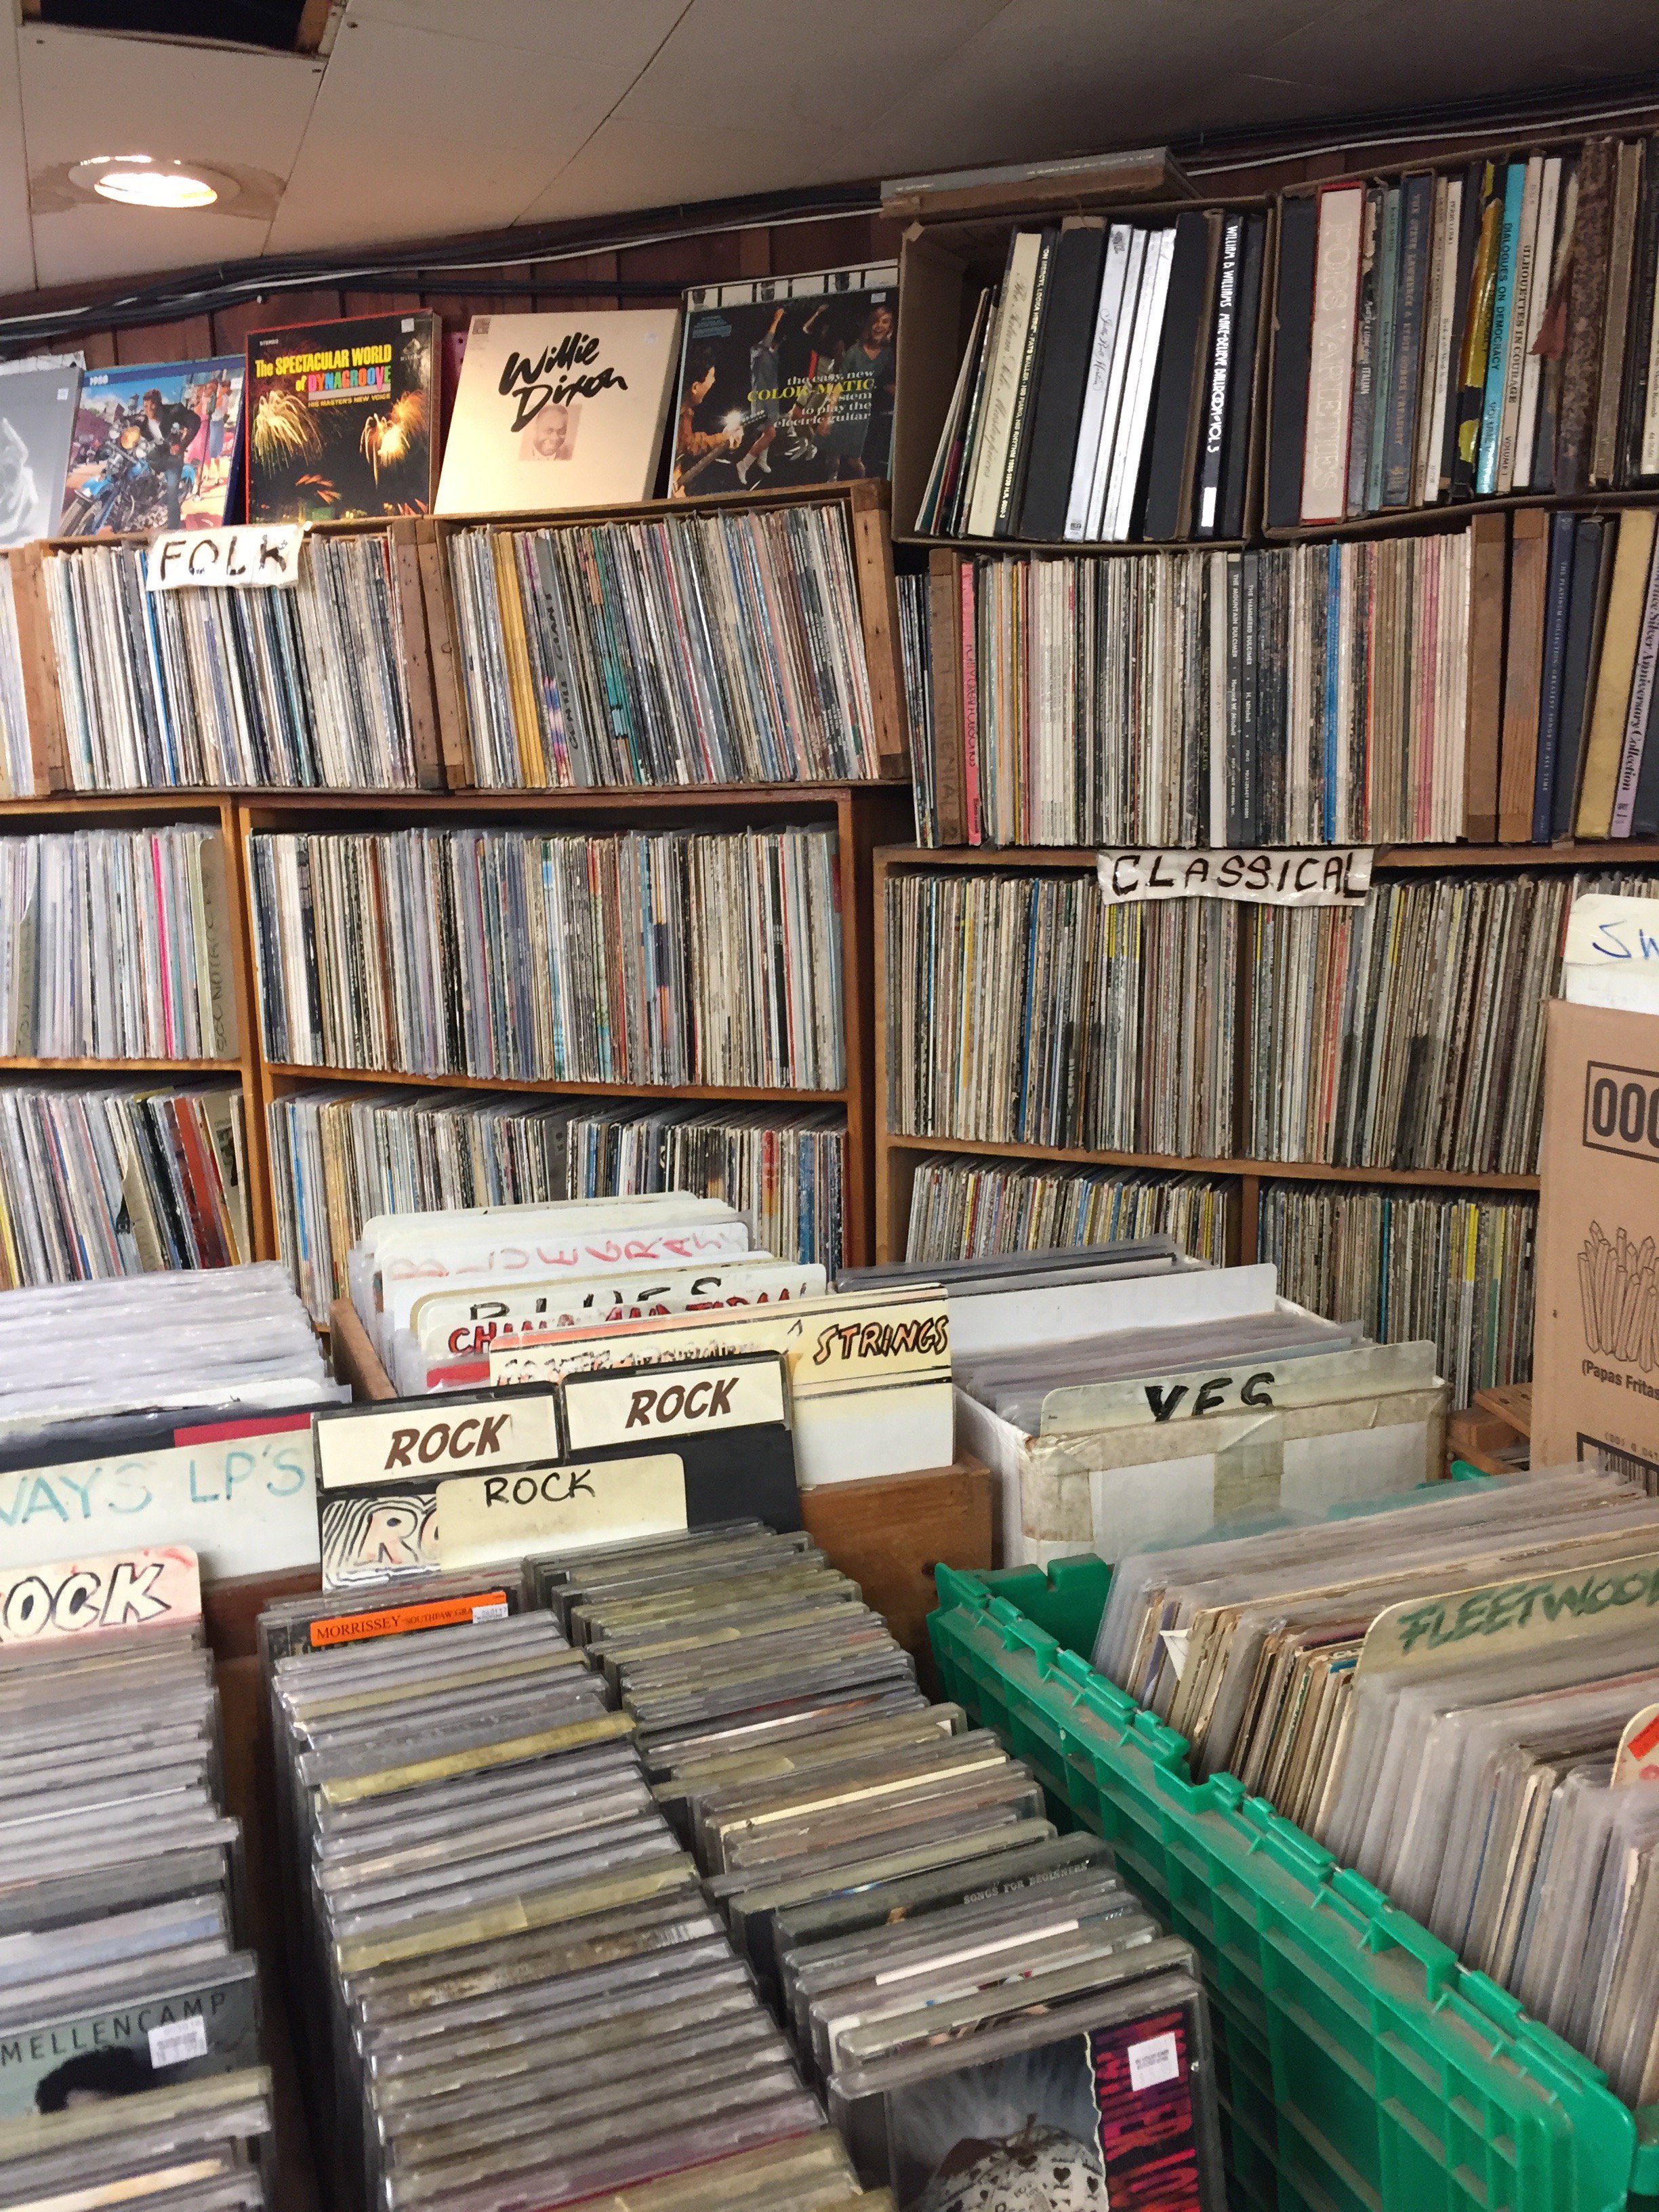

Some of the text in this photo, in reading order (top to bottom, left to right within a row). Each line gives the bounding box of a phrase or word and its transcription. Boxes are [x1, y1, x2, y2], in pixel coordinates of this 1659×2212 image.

[1223, 224, 1237, 260] WILLIAM
[1218, 269, 1233, 308] WILLIAMS
[1490, 222, 1513, 371] DIALOGUES ON DEMOCRACY
[1025, 336, 1035, 354] FATS
[1213, 312, 1230, 366] MAKE-BELIEVE
[1311, 220, 1352, 491] POPS VARIETIES
[1513, 329, 1523, 344] IN
[255, 344, 392, 378] The SPECTACULAR WORLD
[295, 365, 391, 392] of DYNAGROOVE
[498, 331, 600, 396] Willie
[847, 370, 875, 379] new
[1021, 354, 1032, 381] WALLER
[1359, 367, 1372, 395] ITALIAN
[1507, 346, 1521, 403] COURAGE
[371, 393, 390, 401] VOICE
[510, 367, 628, 432] Dixon
[802, 407, 814, 415] to
[849, 401, 872, 411] the
[773, 415, 824, 428] electric
[827, 411, 872, 425] guitar
[1008, 430, 1019, 457] RHYTHM
[160, 534, 287, 581] FOLK
[1643, 611, 1659, 650] Silver
[1628, 651, 1654, 730] Anniversary
[1621, 730, 1642, 792] Collection
[1112, 853, 1368, 899] CLASSICAL
[813, 1314, 949, 1366] STRINGS
[1582, 1359, 1622, 1387] (Papas
[626, 1378, 739, 1429] ROCK
[384, 1414, 510, 1471] ROCK
[189, 1444, 306, 1504] LP'S
[485, 1468, 595, 1507] ROCK
[1, 1562, 171, 1639] OCK
[316, 1616, 401, 1640] MORRISSEY
[407, 1612, 453, 1624] SOUTHPAW
[963, 1862, 1089, 1905] SONGS FOR BEGINNERS
[1, 1991, 225, 2066] MELLENCAMP
